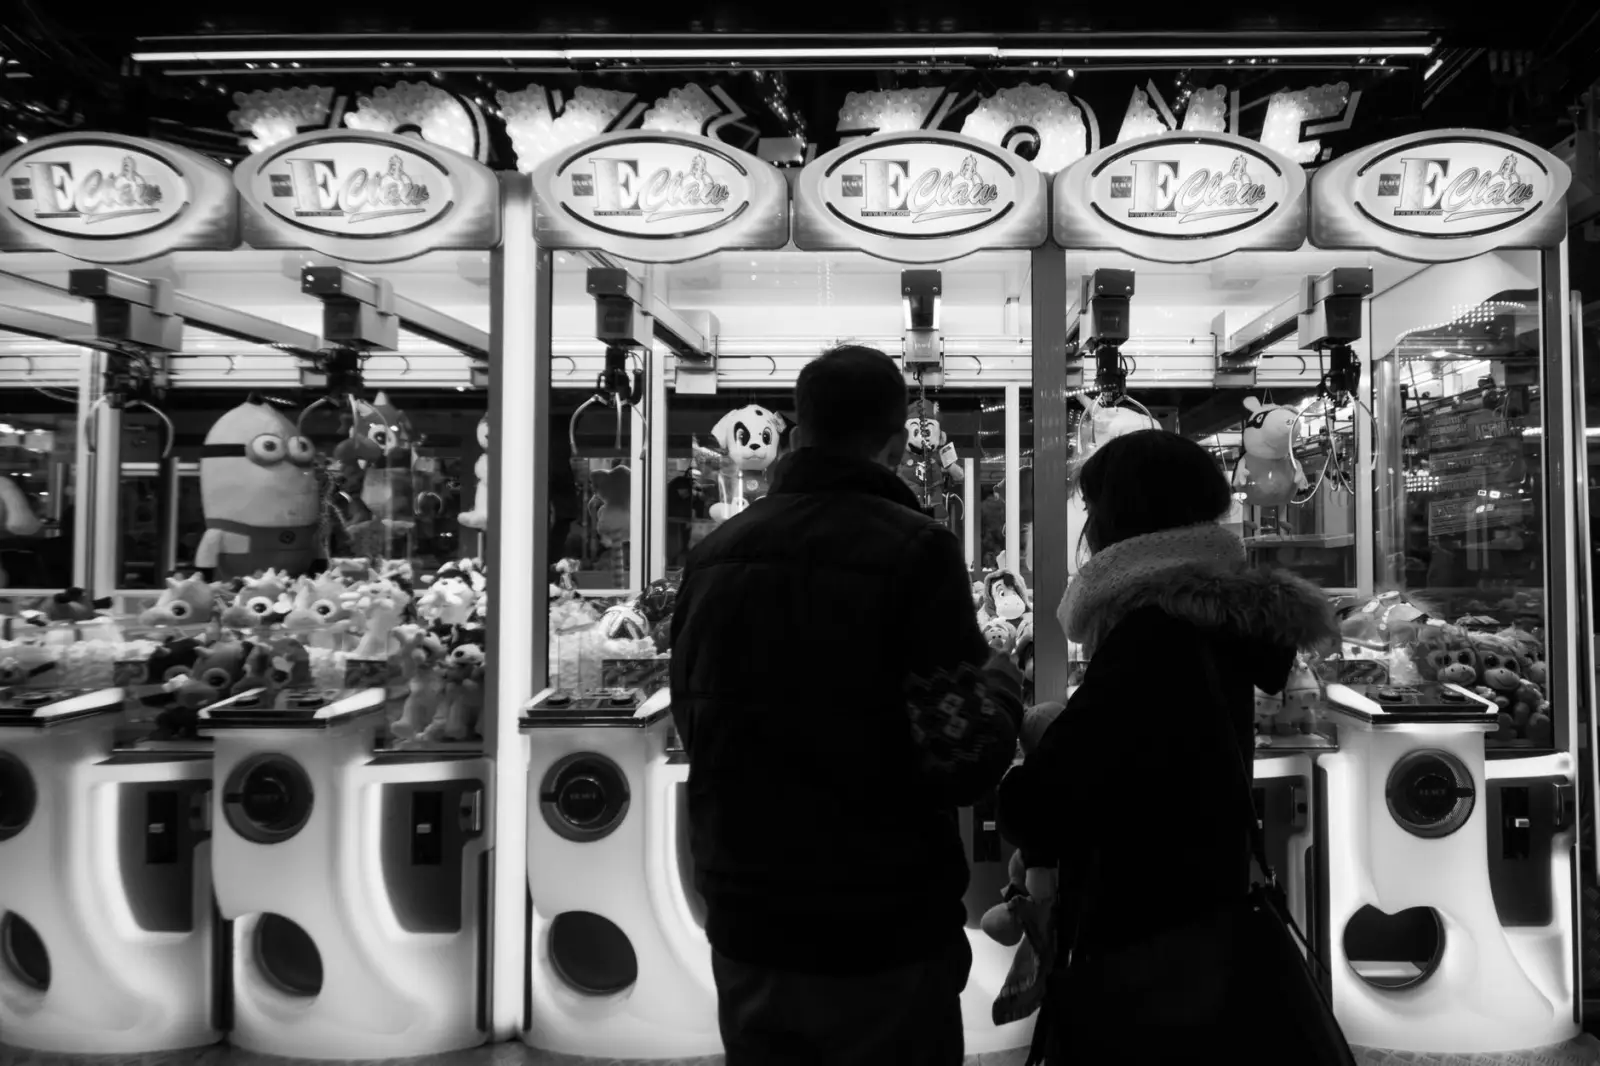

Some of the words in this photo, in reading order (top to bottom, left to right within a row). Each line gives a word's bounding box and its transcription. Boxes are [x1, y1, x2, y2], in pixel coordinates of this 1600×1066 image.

[25, 161, 81, 214] E
[285, 158, 341, 211] E
[589, 158, 641, 210] E
[860, 159, 909, 210] E
[1129, 160, 1180, 211] E
[1395, 158, 1450, 210] E
